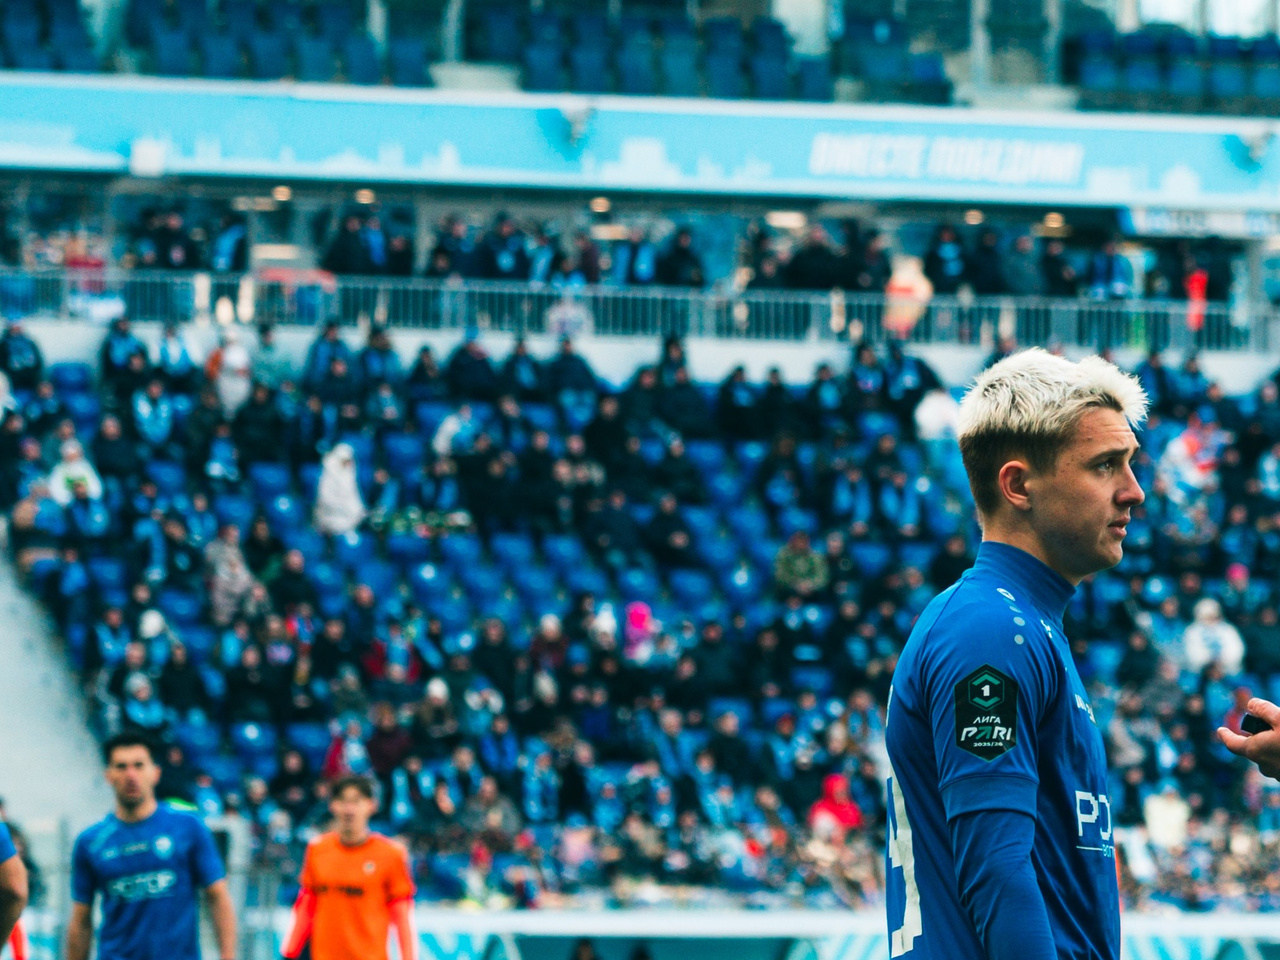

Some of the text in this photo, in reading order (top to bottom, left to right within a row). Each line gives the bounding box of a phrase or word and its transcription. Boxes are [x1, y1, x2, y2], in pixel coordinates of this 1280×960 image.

[981, 685, 990, 697] 1
[973, 716, 1001, 724] ЛИГА
[961, 726, 1012, 741] PARI
